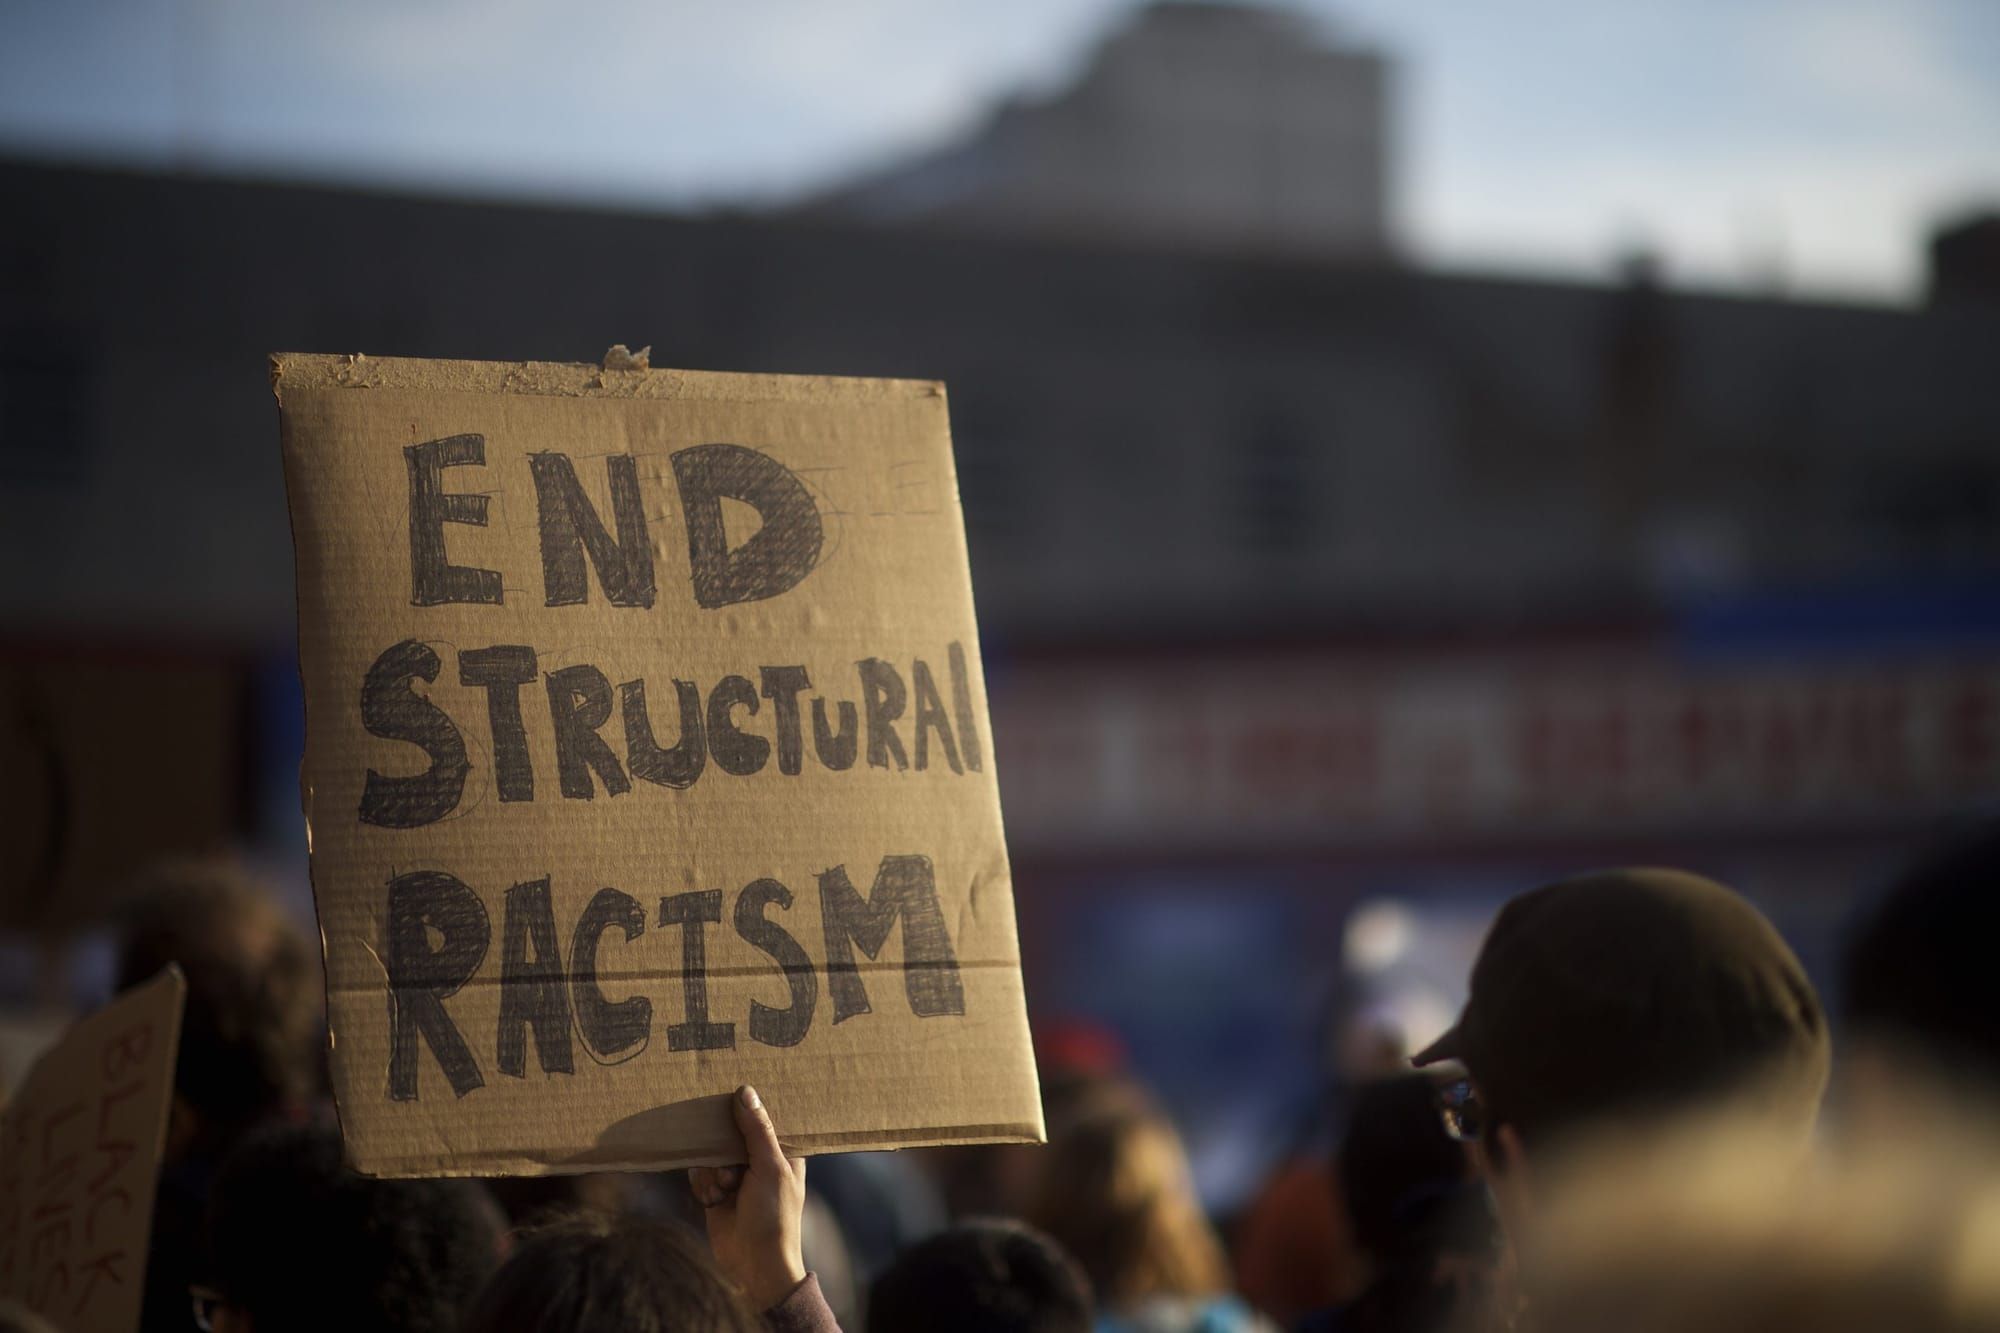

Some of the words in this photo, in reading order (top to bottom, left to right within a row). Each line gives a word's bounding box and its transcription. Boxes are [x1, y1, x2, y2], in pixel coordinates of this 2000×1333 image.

[403, 433, 824, 609] END
[385, 854, 964, 1101] RACISM
[73, 1021, 153, 1316] BLACK
